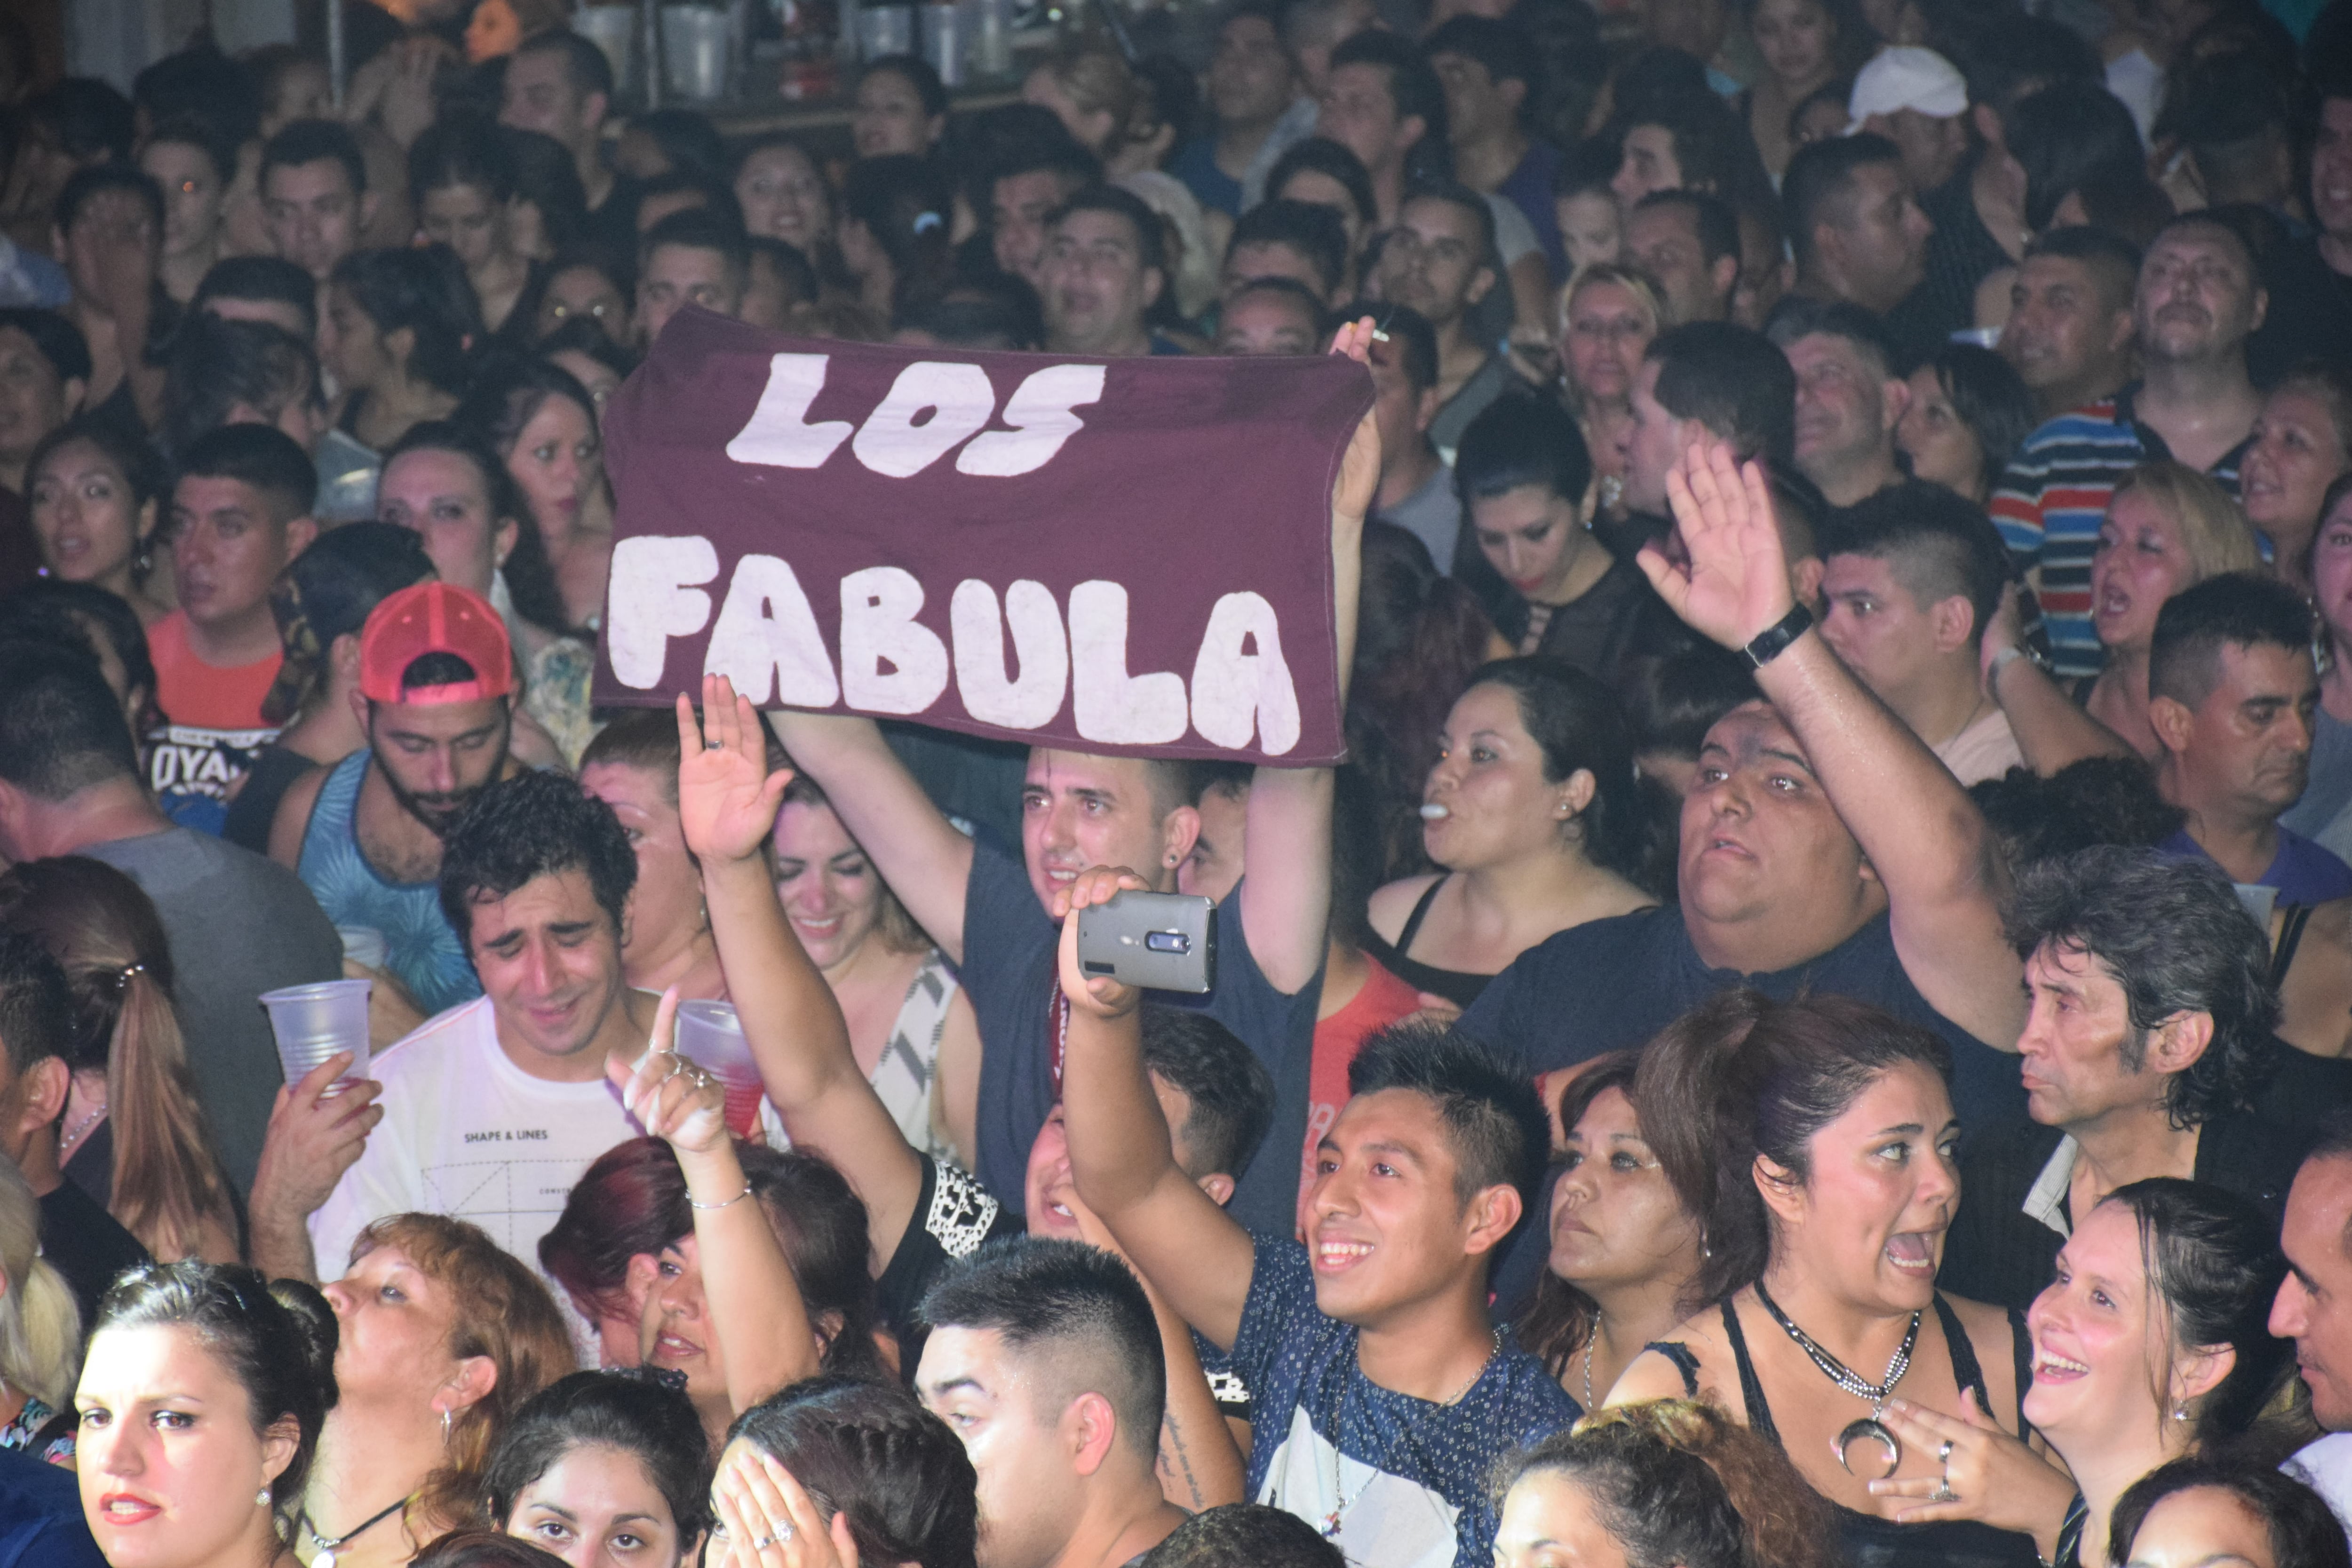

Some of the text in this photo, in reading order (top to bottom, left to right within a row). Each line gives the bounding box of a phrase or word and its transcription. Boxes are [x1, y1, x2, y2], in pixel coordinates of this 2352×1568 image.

[726, 353, 1106, 478] LOS
[608, 535, 1300, 756] FABULA
[464, 1130, 548, 1143] SHAPE & LINES
